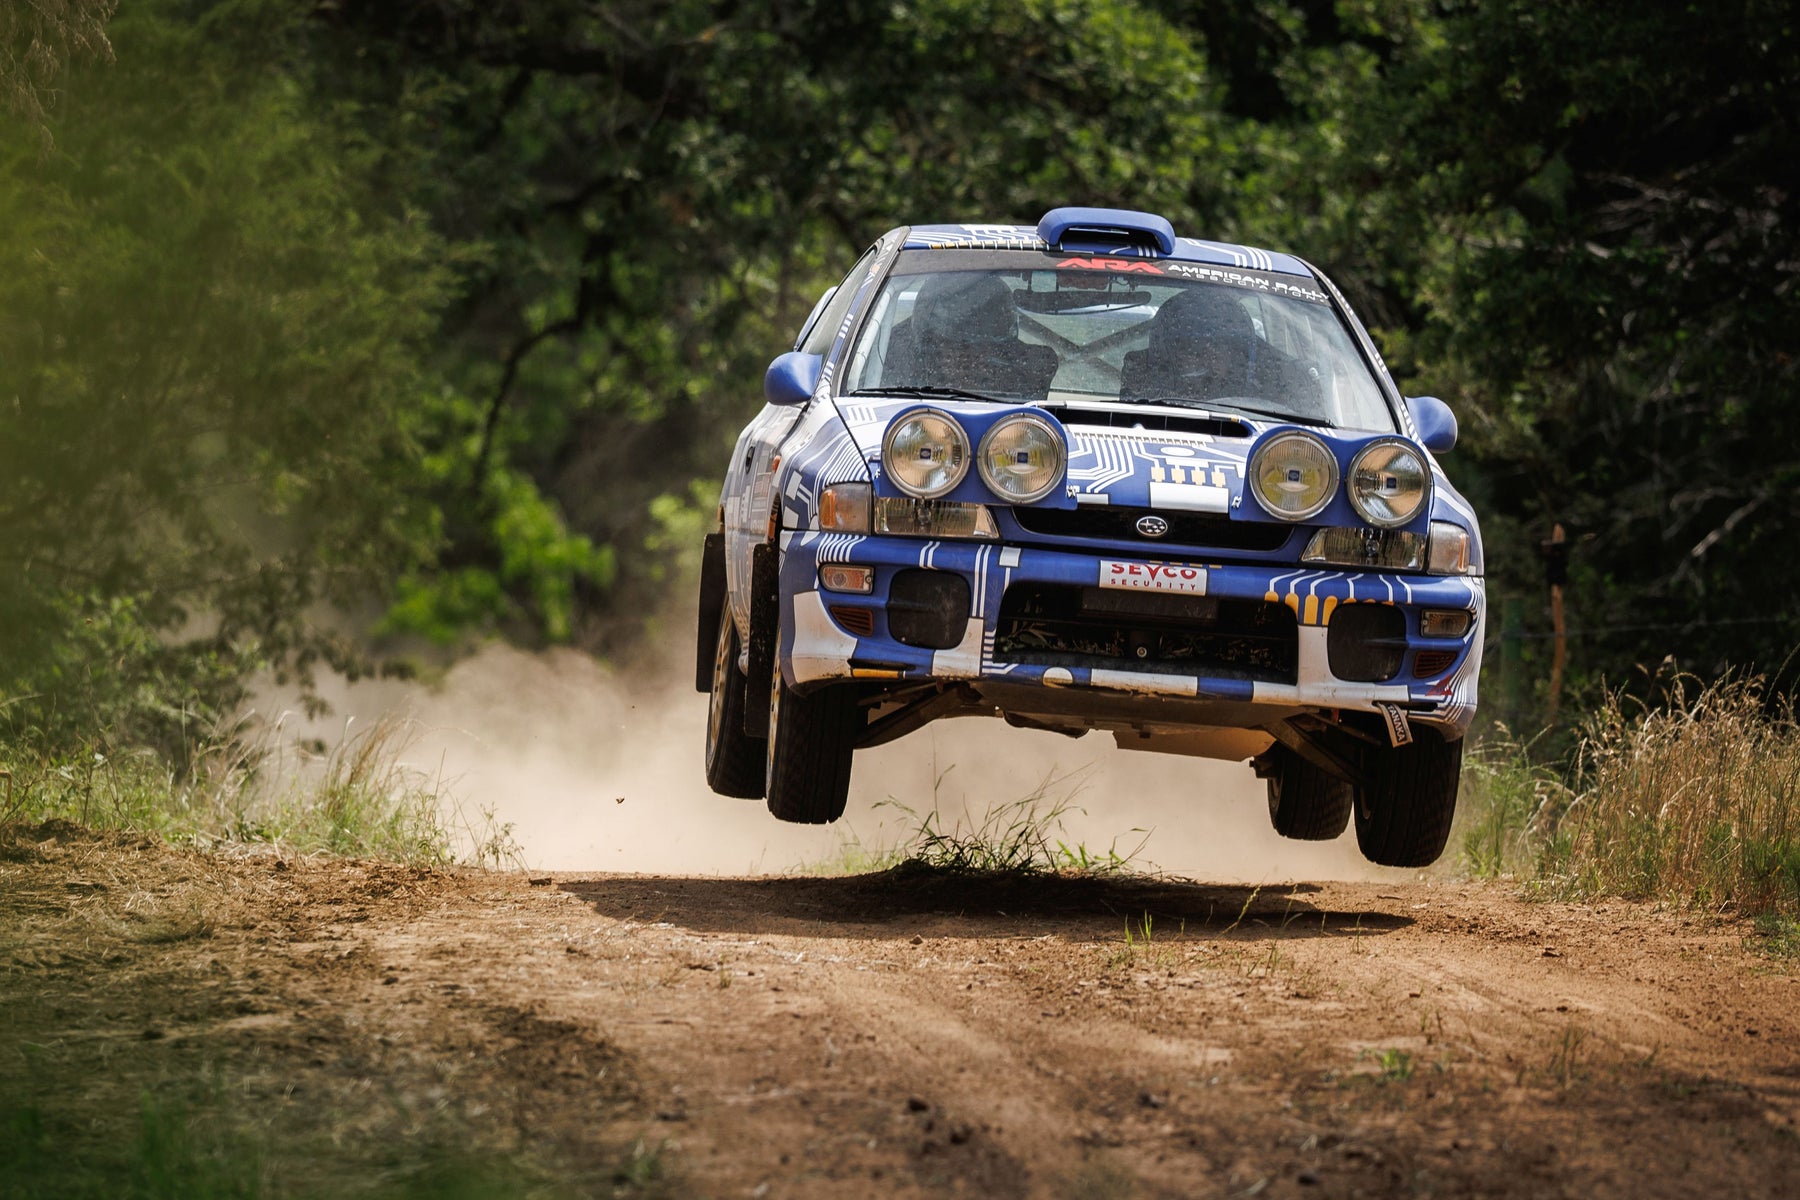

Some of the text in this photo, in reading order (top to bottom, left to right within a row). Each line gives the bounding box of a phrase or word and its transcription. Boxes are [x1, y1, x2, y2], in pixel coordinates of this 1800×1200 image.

[1056, 256, 1164, 274] ARA
[1168, 264, 1329, 300] AMERICAN RALLY
[1182, 272, 1316, 300] ASSOCIATION
[1111, 563, 1197, 581] SEVCO
[1111, 578, 1196, 590] SECURITY
[1388, 705, 1405, 741] TANAKA
